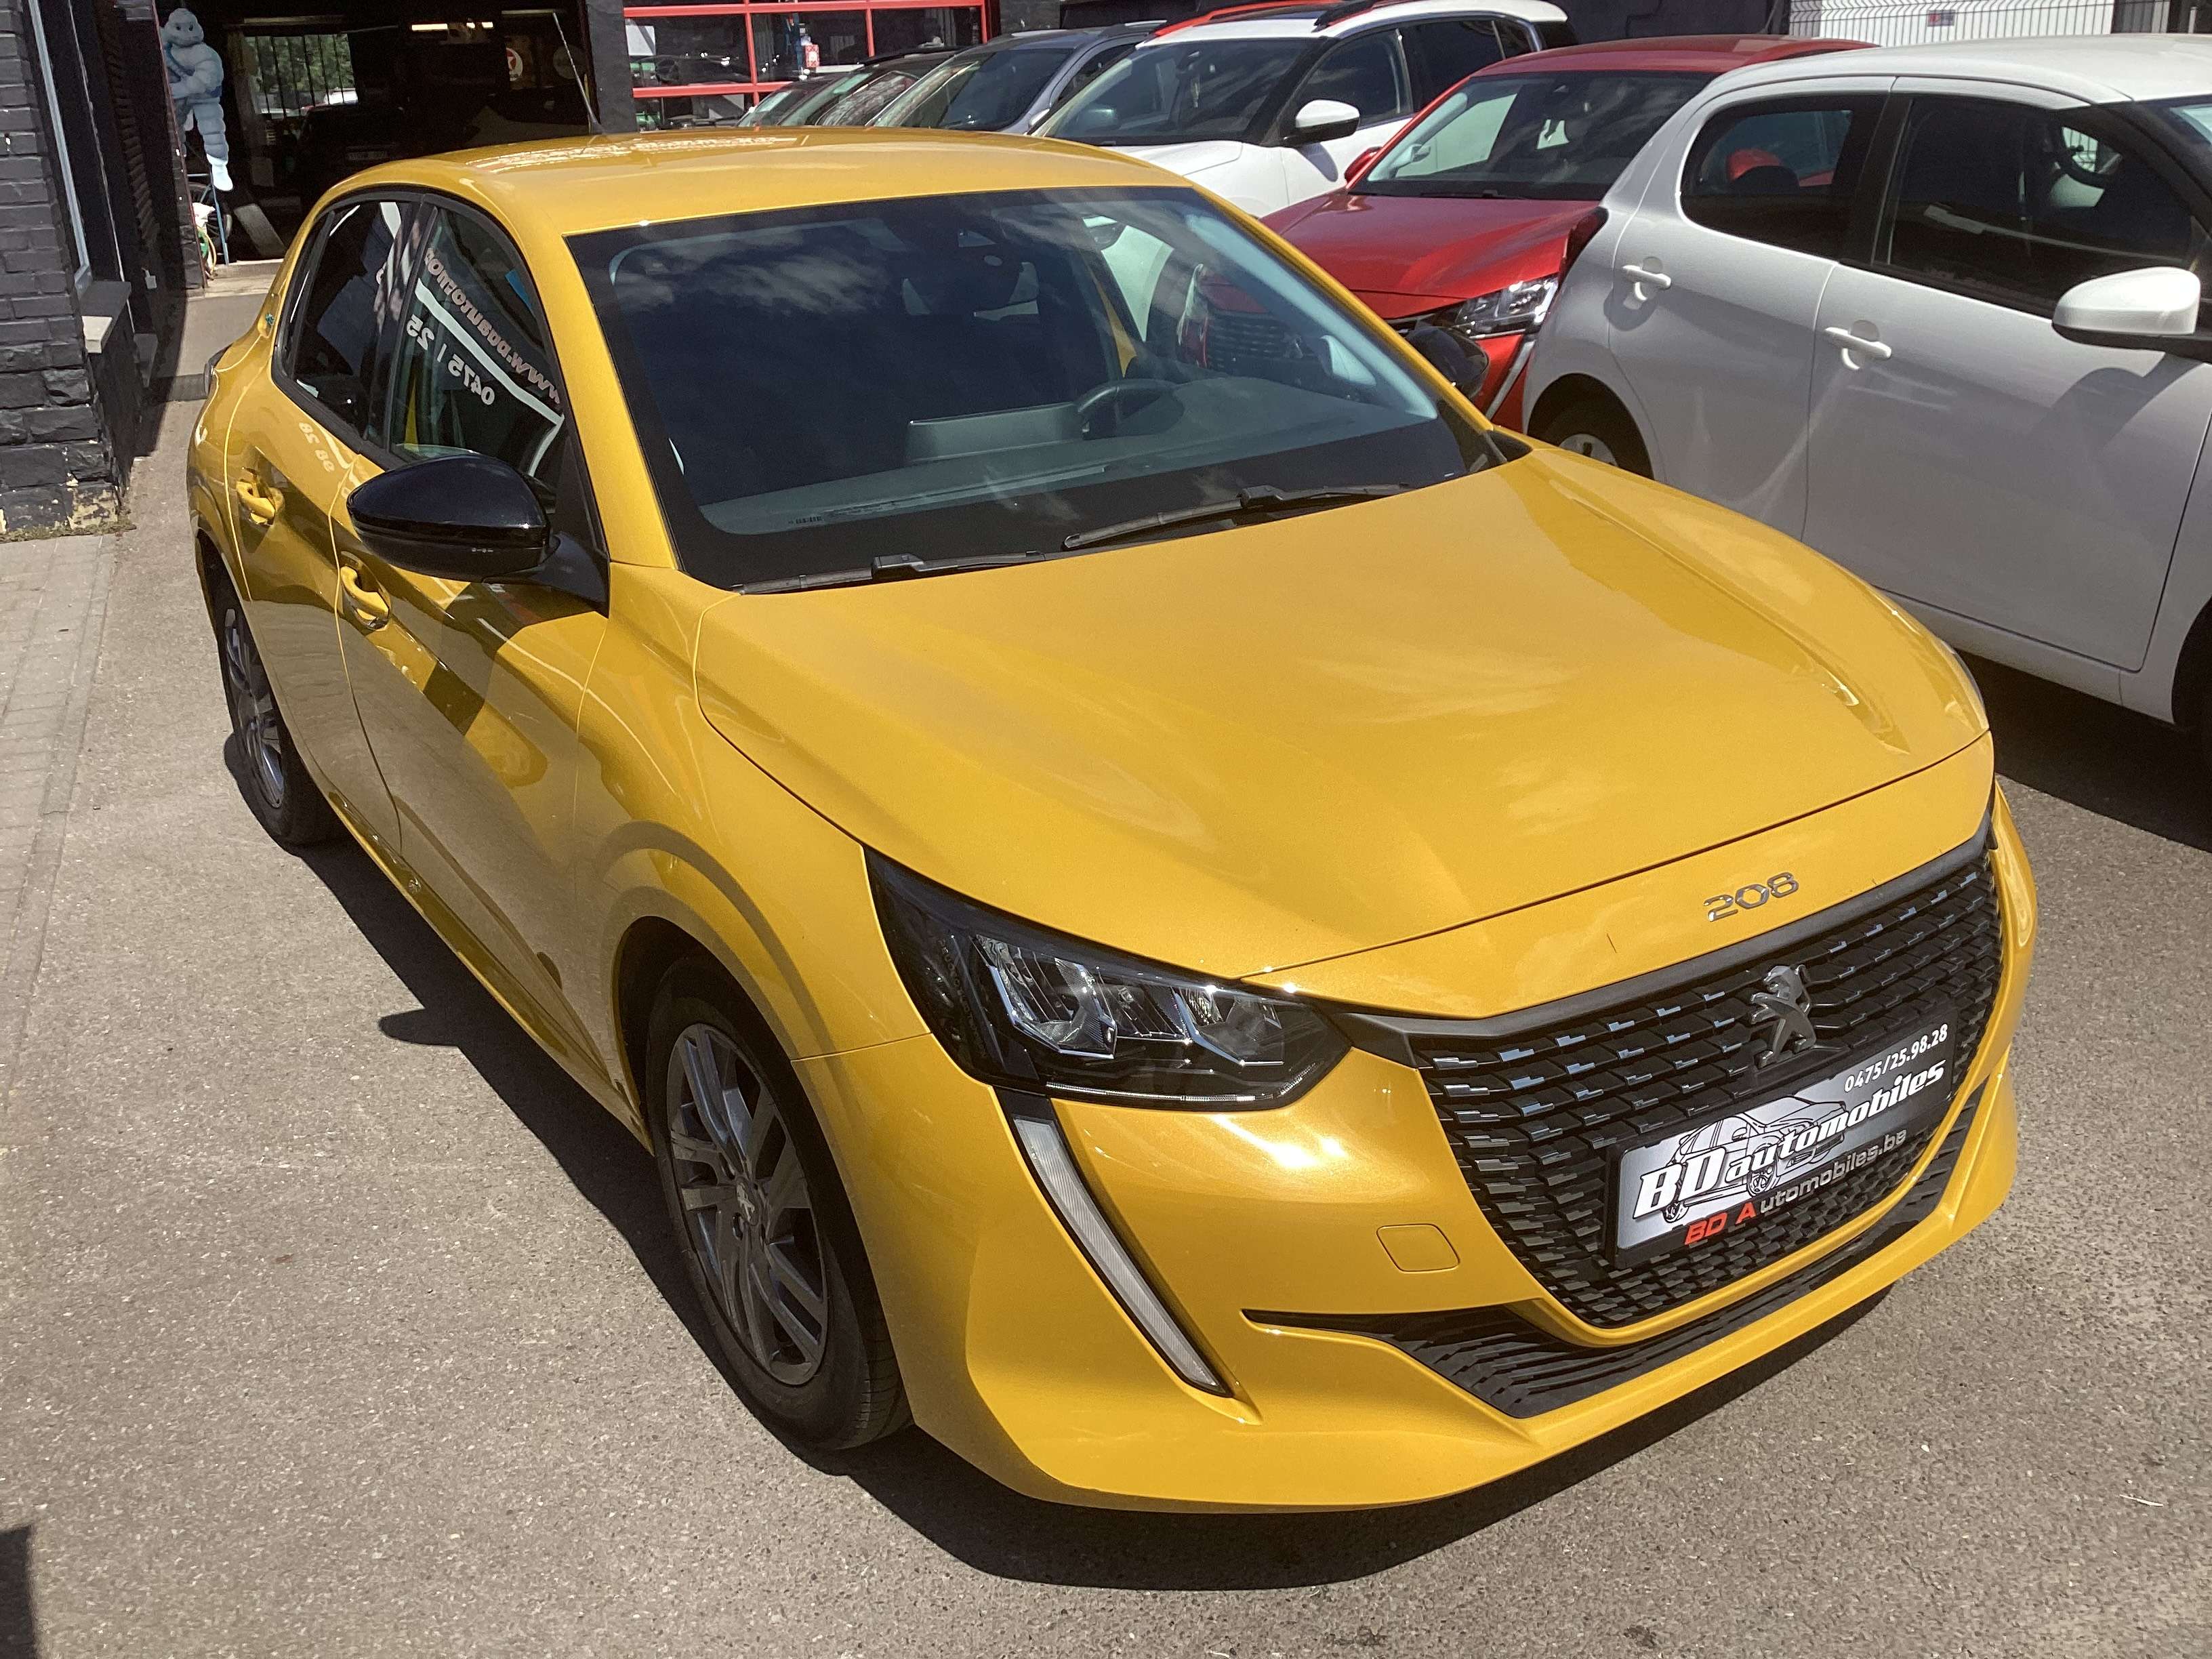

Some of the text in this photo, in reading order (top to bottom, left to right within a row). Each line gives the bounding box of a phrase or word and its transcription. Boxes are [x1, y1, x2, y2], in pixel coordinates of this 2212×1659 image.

[1703, 872, 1799, 922] 208
[1845, 1023, 1948, 1092] 0475/25.98.28
[1684, 1212, 1727, 1246] BD
